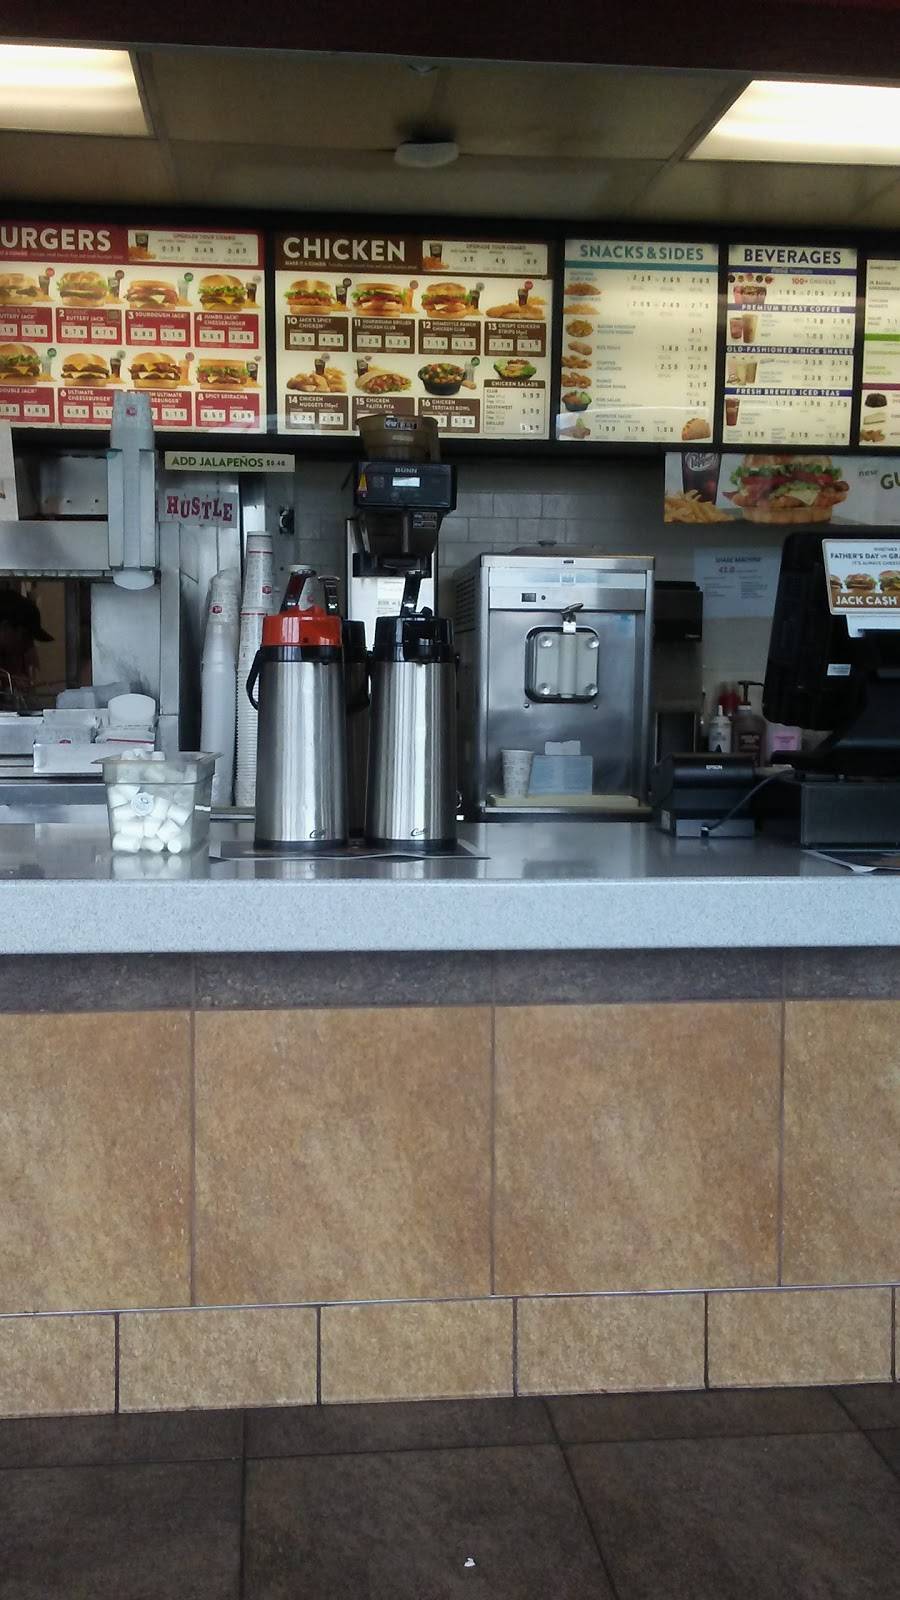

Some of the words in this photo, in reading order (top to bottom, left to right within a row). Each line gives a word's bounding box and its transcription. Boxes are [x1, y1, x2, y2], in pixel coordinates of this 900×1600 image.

[0, 226, 111, 251] URGERS
[283, 237, 405, 261] CHICKEN
[744, 249, 841, 265] BEVERAGES
[742, 304, 778, 312] PREMIUM
[59, 309, 64, 317] 2
[287, 317, 297, 325] 10
[354, 319, 361, 327] 11
[422, 321, 431, 329] 12
[488, 323, 497, 331] 13
[288, 396, 298, 404] 14
[356, 397, 365, 406] 15
[172, 456, 196, 466] ADD
[200, 456, 264, 468] JALAPEÑOS
[858, 469, 878, 477] new
[166, 495, 232, 522] HUSTLE
[836, 596, 863, 605] JACK
